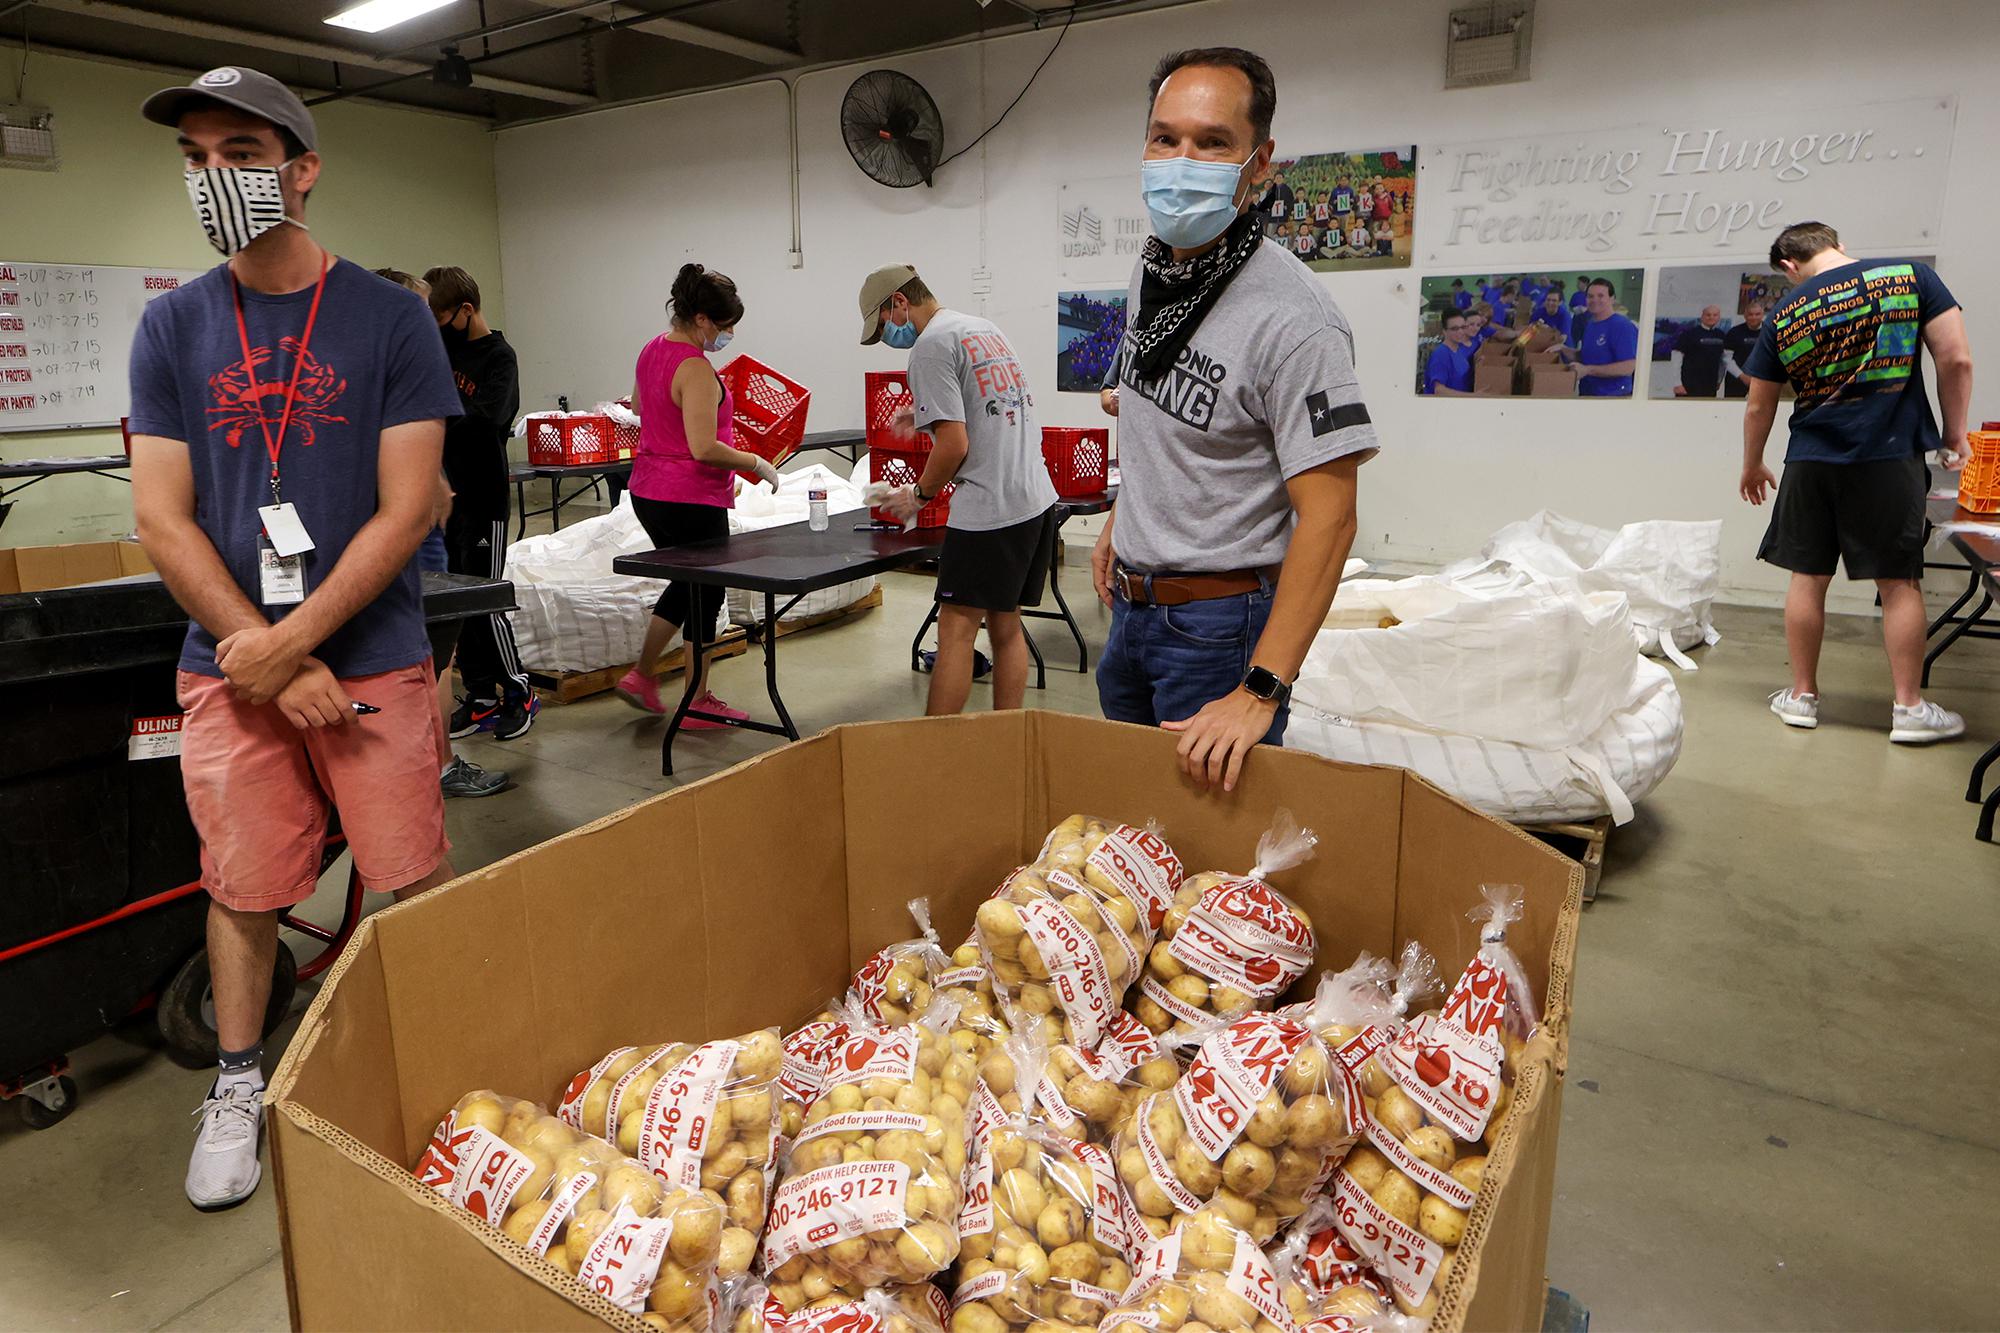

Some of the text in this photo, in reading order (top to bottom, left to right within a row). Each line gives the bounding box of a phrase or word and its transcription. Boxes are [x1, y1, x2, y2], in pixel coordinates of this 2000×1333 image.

[1448, 143, 1641, 202] Fighting
[1444, 202, 1621, 252] Feeding
[1063, 242, 1101, 258] USAA
[1818, 278, 1859, 296] SUGAR
[1866, 278, 1891, 290] BOY
[1808, 296, 1864, 322] BELONGS
[1867, 290, 1882, 301] TO
[1886, 285, 1910, 296] YOU
[6, 369, 32, 382] PROTEIN
[11, 395, 35, 409] PANTRY
[138, 718, 179, 733] ULINE
[1058, 907, 1089, 941] ANTONIO
[1085, 936, 1101, 963] FOOD
[1174, 947, 1201, 966] program
[1201, 961, 1210, 969] of
[1209, 963, 1221, 976] the
[1221, 970, 1234, 984] San
[1144, 978, 1160, 995] Fruits
[1162, 992, 1200, 1022] Vegetables
[867, 1065, 886, 1074] Food
[1340, 1045, 1367, 1068] San
[609, 1088, 621, 1115] Good
[618, 1073, 631, 1087] for
[629, 1060, 649, 1076] your
[1238, 1073, 1262, 1097] TEXAS
[1452, 1070, 1489, 1110] IQ
[643, 1103, 659, 1133] BANK
[824, 1114, 845, 1129] Good
[847, 1114, 860, 1125] for
[862, 1115, 884, 1127] your
[885, 1114, 922, 1127] Health!
[1207, 1095, 1239, 1133] IQ
[1401, 1075, 1476, 1136] Antonio Food Bank
[460, 1132, 483, 1168] TEXAS
[640, 1132, 652, 1161] FOOD
[1148, 1145, 1158, 1161] for
[1196, 1130, 1217, 1153] Bank
[479, 1150, 510, 1191] IQ
[790, 1162, 896, 1195] FOOD BANK HELP CENTER
[1152, 1160, 1169, 1179] your
[1376, 1128, 1395, 1152] Good
[1393, 1145, 1408, 1163] for
[1405, 1157, 1430, 1179] your
[1429, 1172, 1472, 1205] Health!
[494, 1165, 529, 1217] Food Bank
[538, 1212, 560, 1244] your
[554, 1174, 590, 1214] Helth!
[968, 1217, 988, 1230] Bank
[1127, 1207, 1149, 1243] CENTER
[1344, 1179, 1427, 1252] BANK HELP CENTER
[974, 1275, 1001, 1293] Health!
